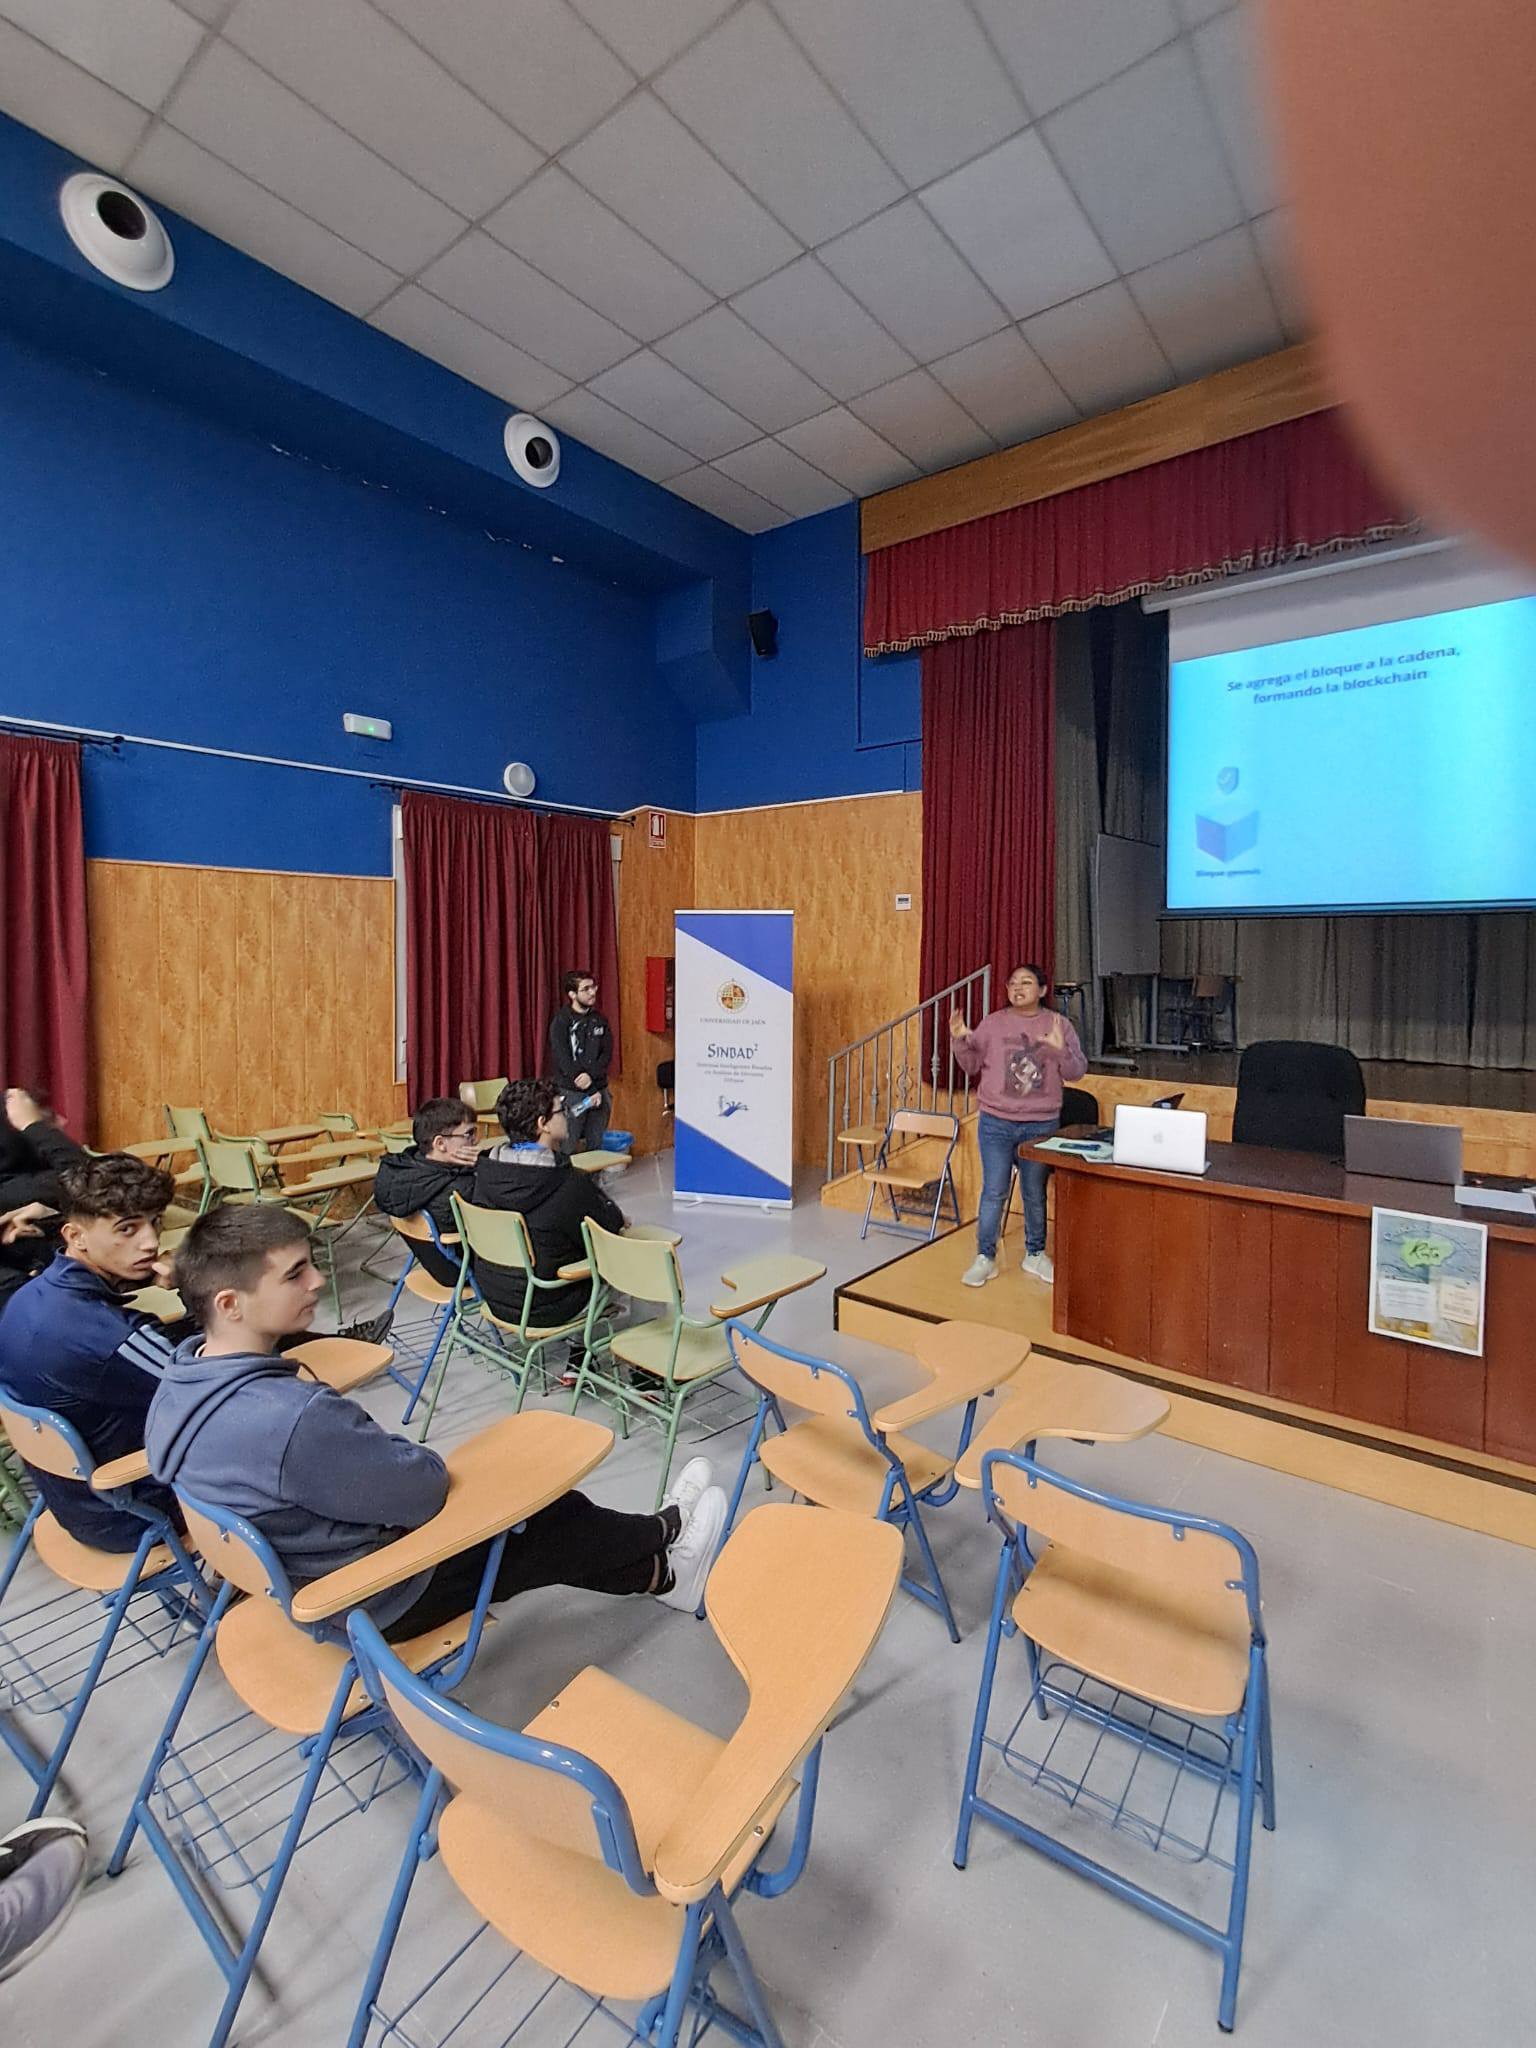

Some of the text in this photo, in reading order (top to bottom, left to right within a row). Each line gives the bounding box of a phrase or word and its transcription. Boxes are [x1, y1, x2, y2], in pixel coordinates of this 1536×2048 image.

[1227, 681, 1243, 692] Se
[1246, 674, 1291, 690] agrega
[1295, 668, 1308, 680] el
[1311, 662, 1363, 678] bloque
[1365, 660, 1376, 670] a
[1379, 656, 1393, 667] la
[1253, 669, 1429, 704] formando la blockchain
